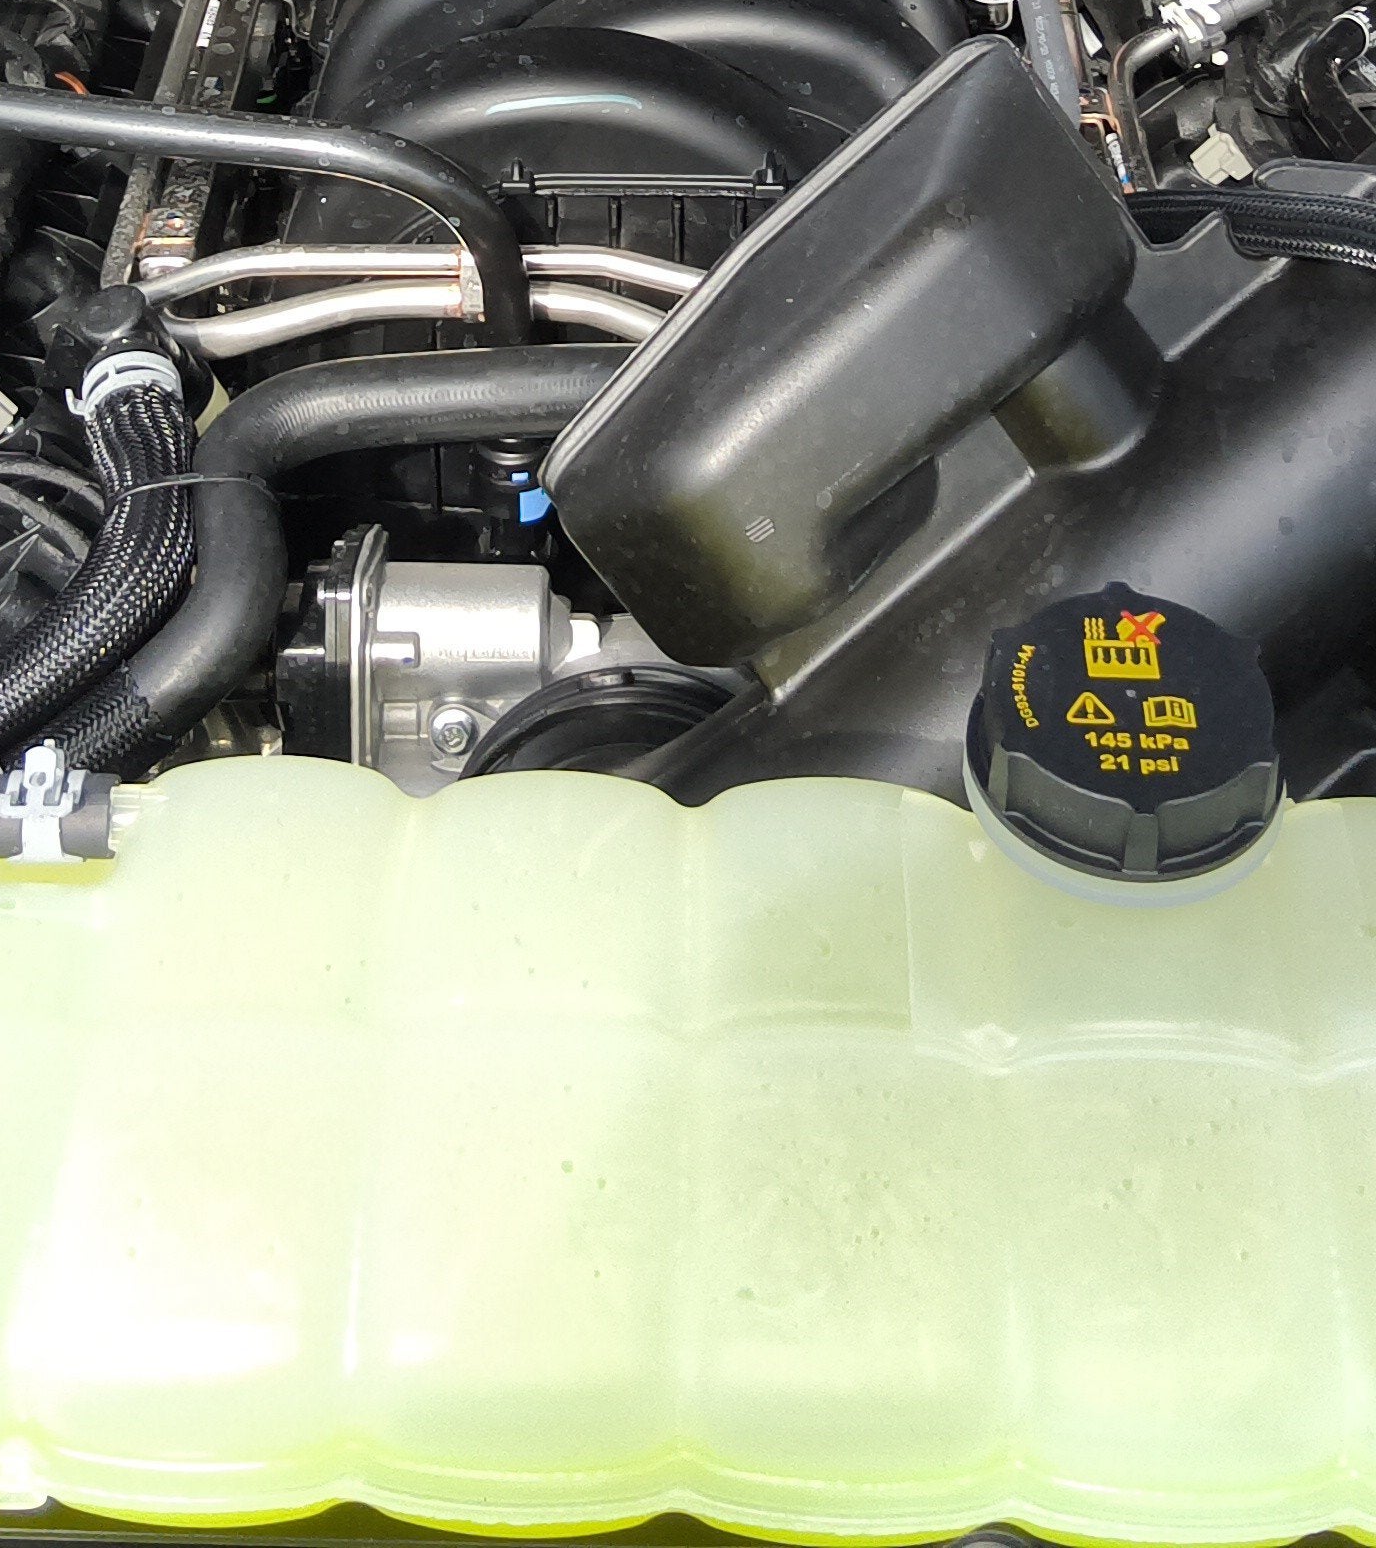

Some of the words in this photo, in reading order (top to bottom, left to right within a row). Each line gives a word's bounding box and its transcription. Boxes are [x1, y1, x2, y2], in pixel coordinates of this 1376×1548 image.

[1085, 731, 1132, 749] 145
[1140, 733, 1191, 751] kPa
[1099, 753, 1130, 771] 21
[1139, 756, 1180, 774] psi
